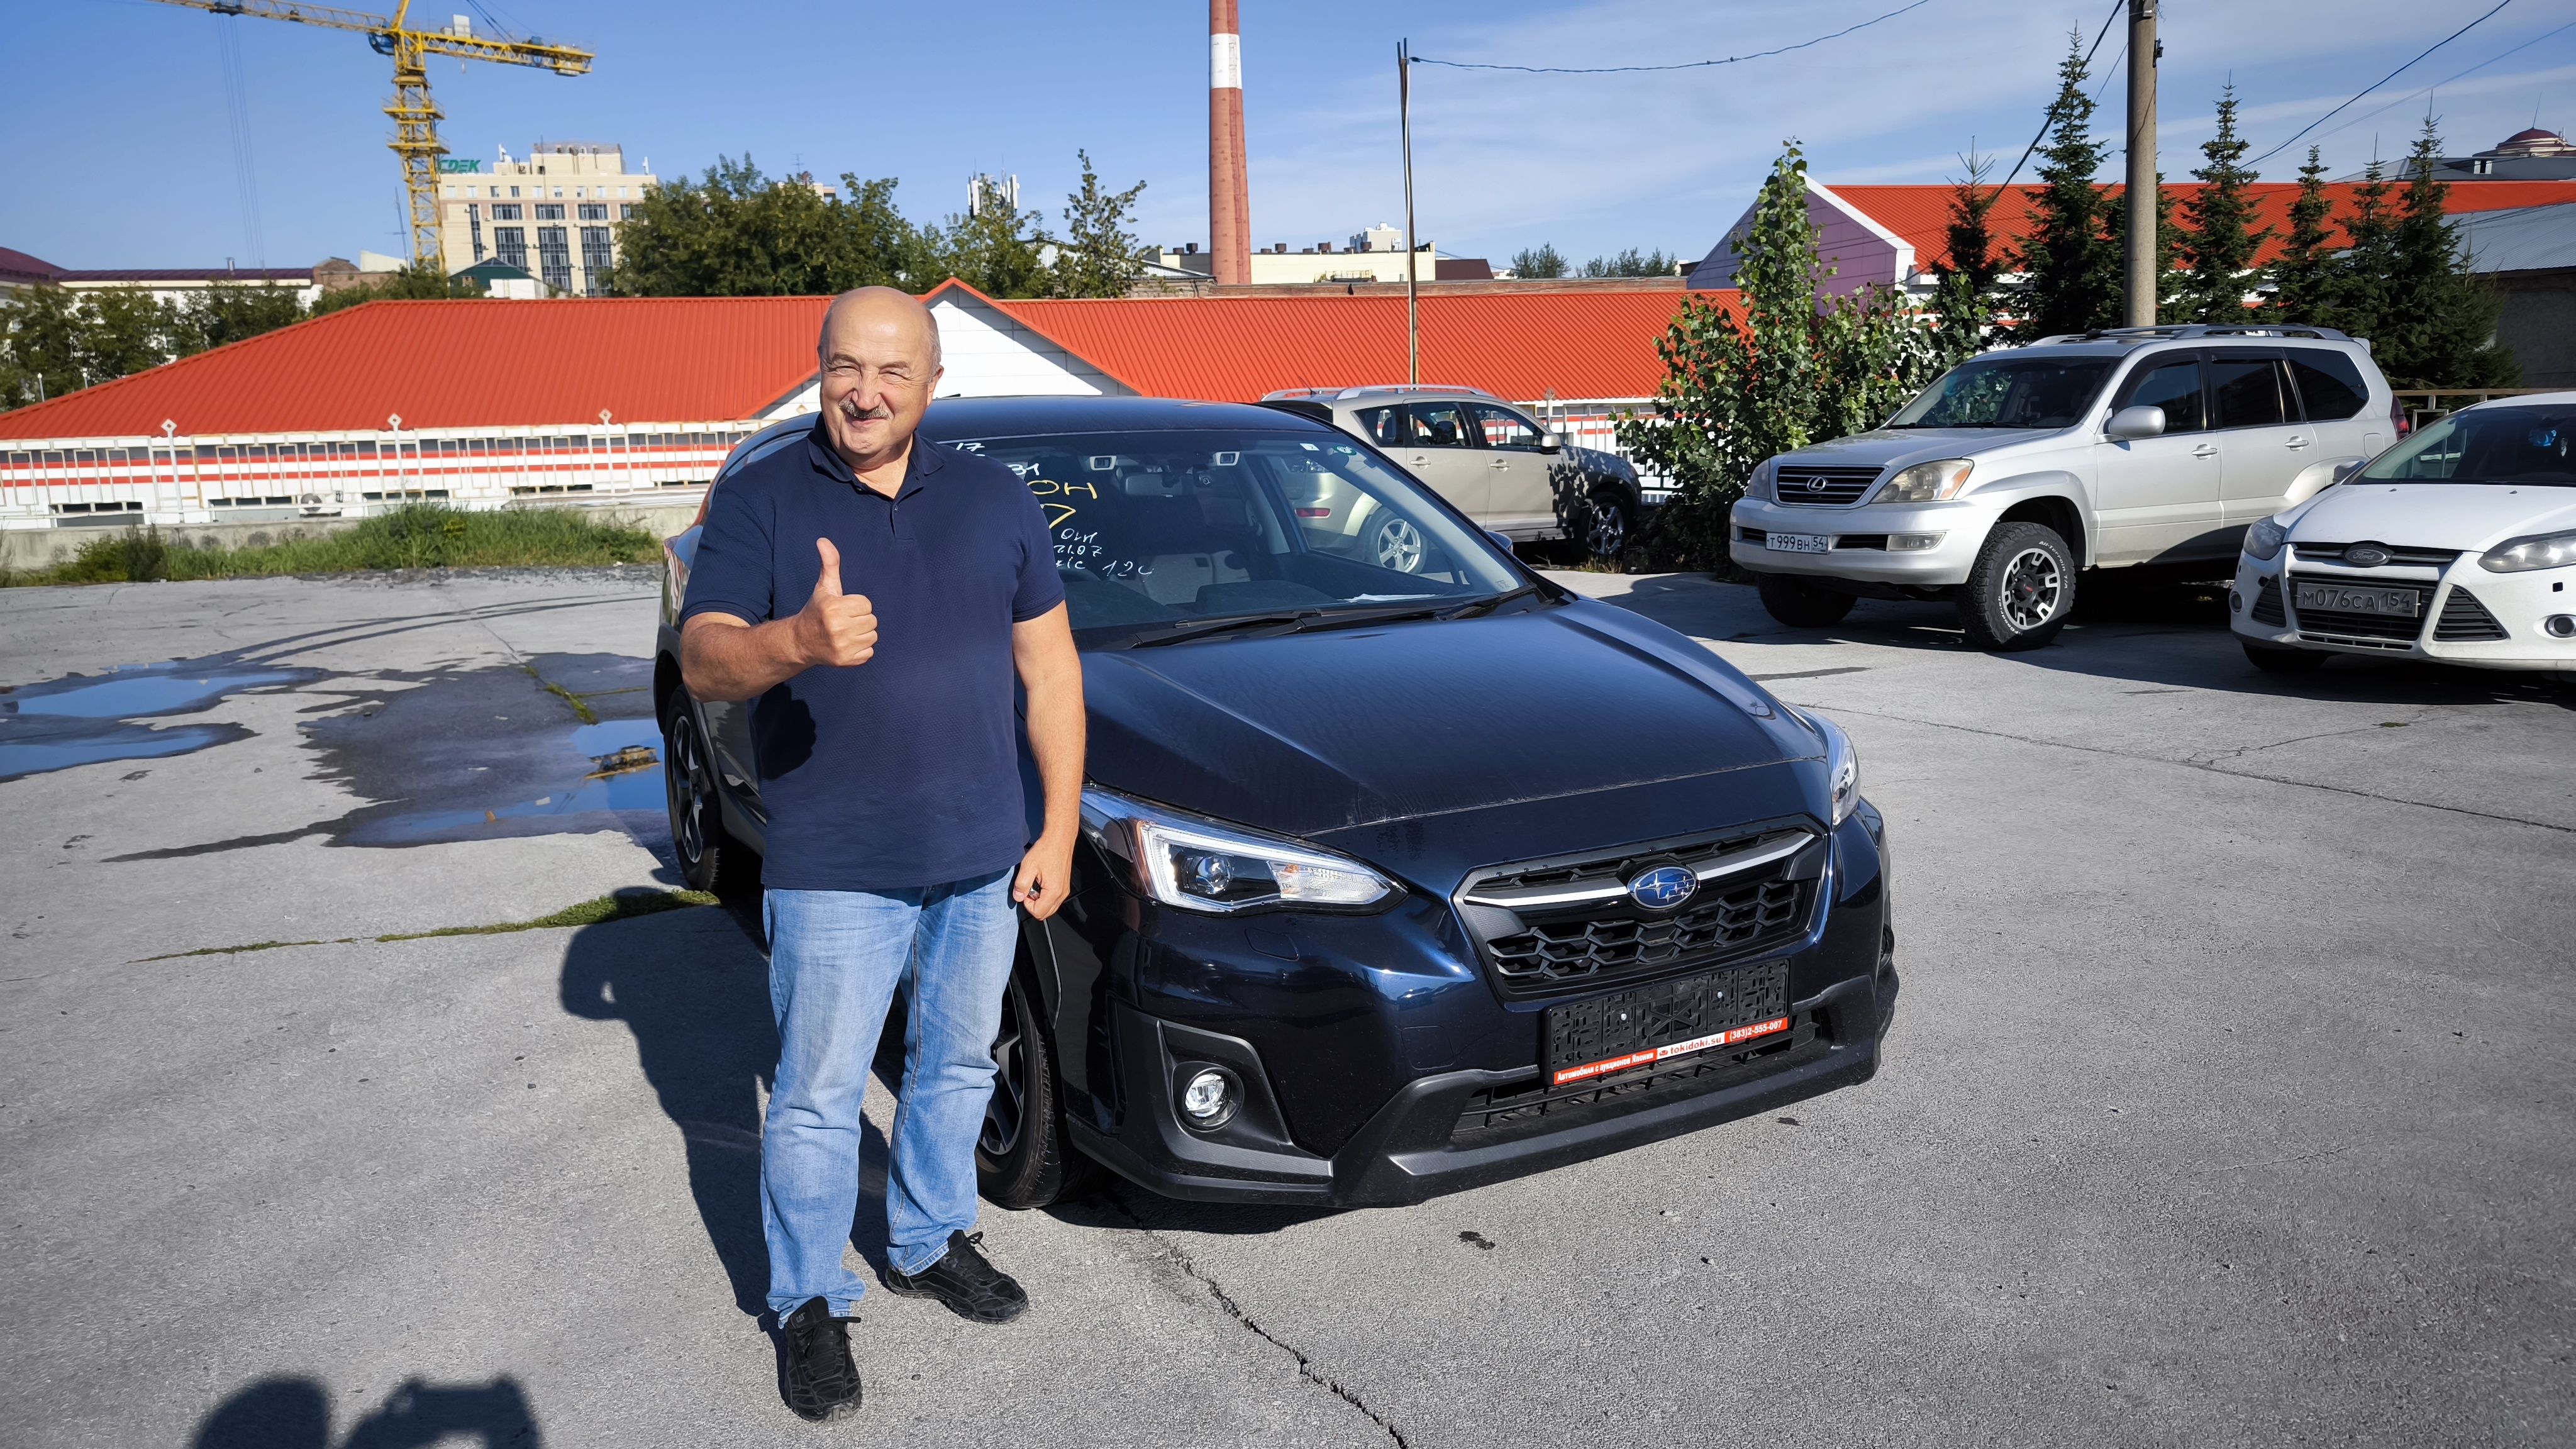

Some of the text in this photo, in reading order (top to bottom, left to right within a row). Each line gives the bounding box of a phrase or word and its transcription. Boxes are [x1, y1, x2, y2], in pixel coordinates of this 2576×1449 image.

[2353, 550, 2375, 560] Ford
[1729, 1019, 1783, 1041] (383)2-555-007
[1670, 1035, 1722, 1055] tokidoki.su
[1557, 1066, 1594, 1081] Автомобили
[1599, 1058, 1631, 1073] аукционов
[1631, 1052, 1654, 1063] Японии
